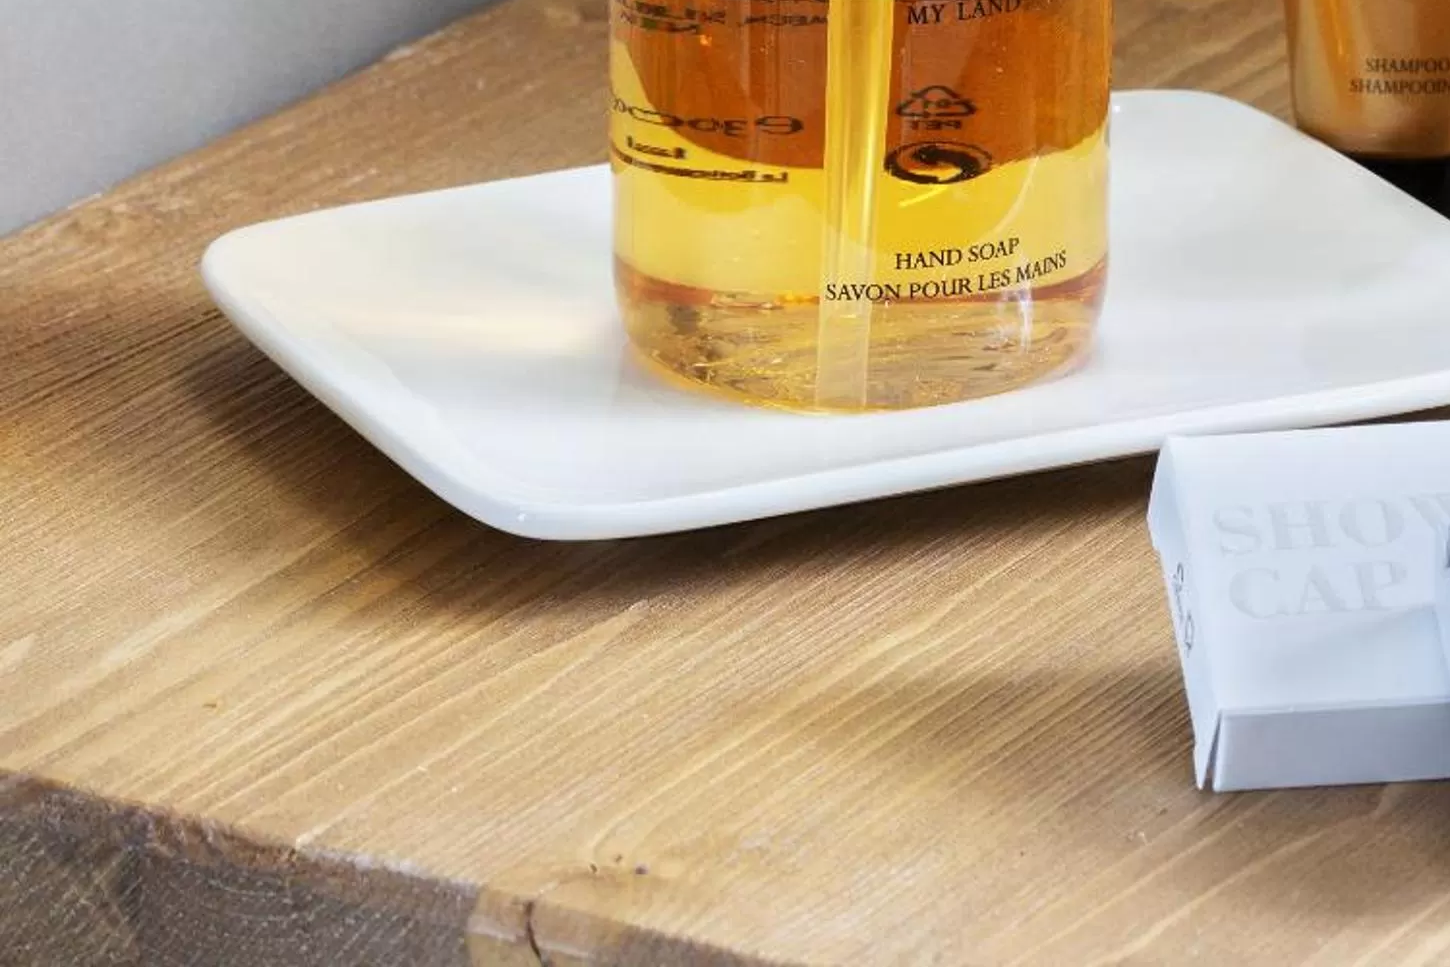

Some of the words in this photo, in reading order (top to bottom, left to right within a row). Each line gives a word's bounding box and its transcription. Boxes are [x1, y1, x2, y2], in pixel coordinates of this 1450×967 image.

[907, 3, 946, 26] MY
[825, 282, 901, 302] SAVON
[908, 276, 973, 301] POUR
[976, 268, 1012, 292] LES
[1015, 248, 1068, 284] MAINS
[894, 248, 963, 271] HAND
[967, 237, 1020, 263] SOAP
[1228, 560, 1408, 620] CAP
